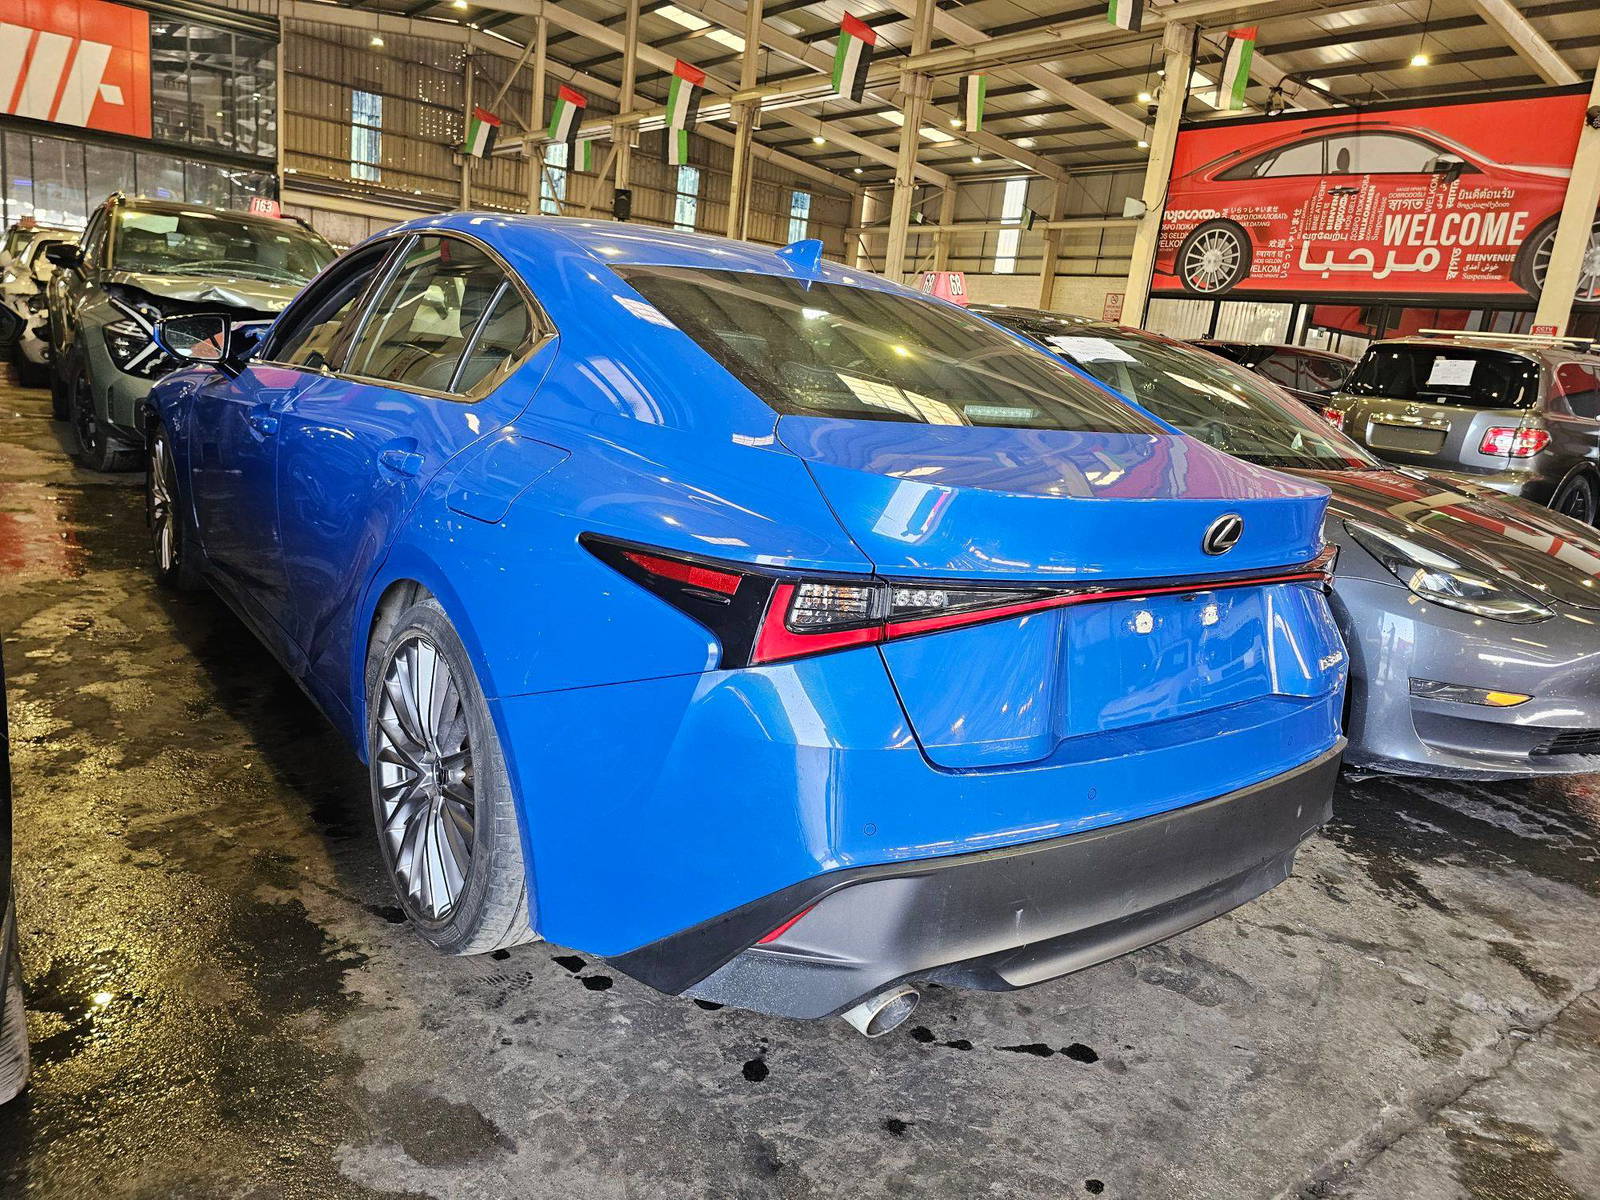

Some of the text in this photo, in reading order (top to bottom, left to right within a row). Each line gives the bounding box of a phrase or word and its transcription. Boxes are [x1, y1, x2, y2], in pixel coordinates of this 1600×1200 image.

[255, 200, 273, 213] 163
[1326, 184, 1342, 231] BIENVENE
[1348, 194, 1357, 214] GELD
[1423, 174, 1440, 214] WELKOM
[1357, 185, 1377, 241] WILLKOMMEN
[1383, 212, 1529, 247] WELCOME
[1298, 240, 1441, 280] مرحبا
[1465, 253, 1517, 262] BIENVENUE
[949, 273, 963, 296] 68
